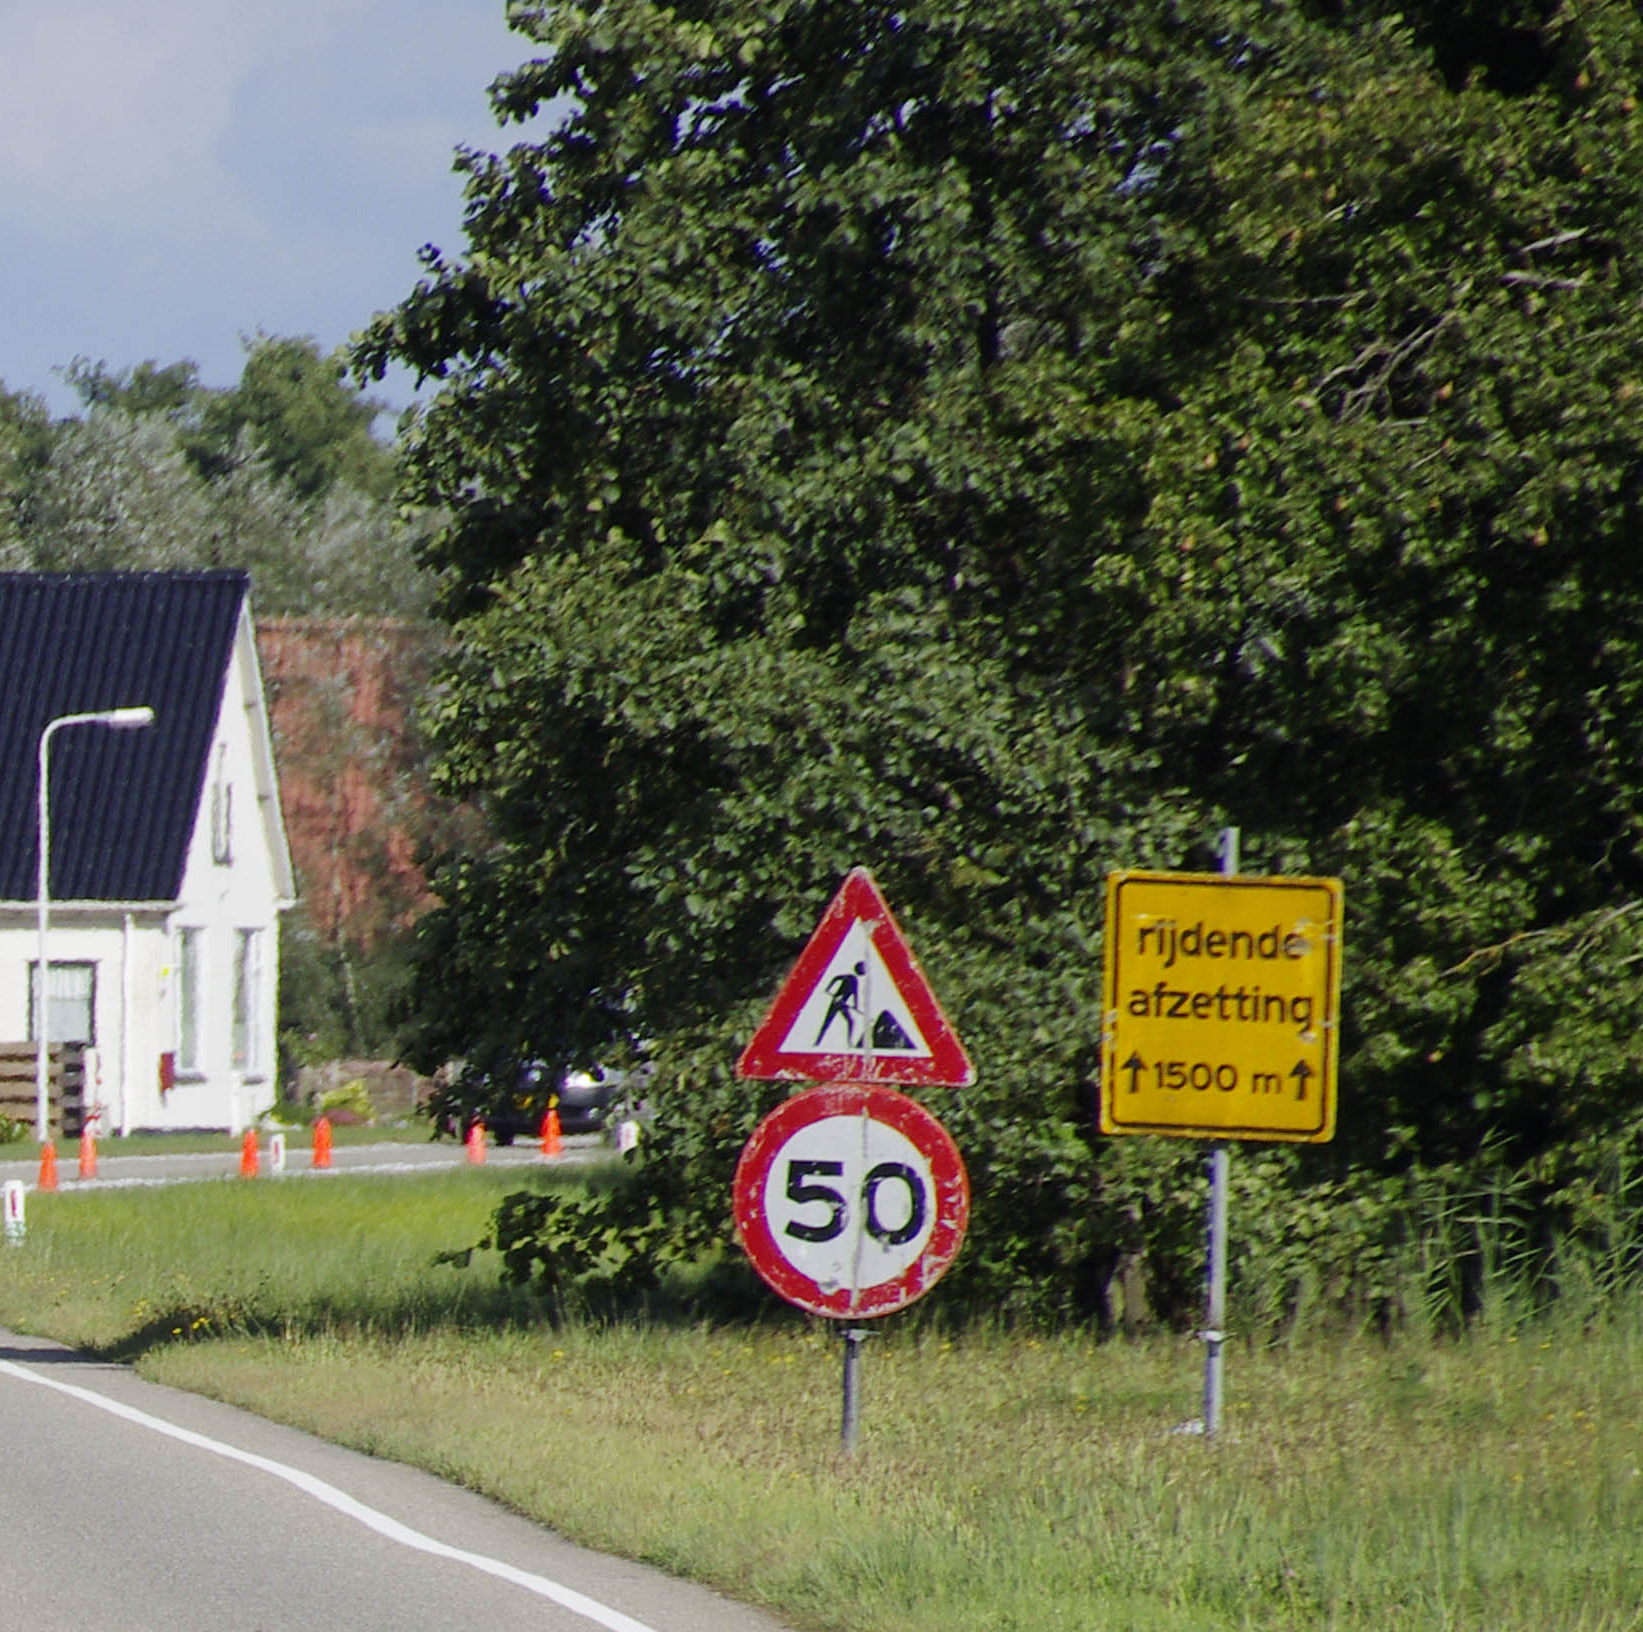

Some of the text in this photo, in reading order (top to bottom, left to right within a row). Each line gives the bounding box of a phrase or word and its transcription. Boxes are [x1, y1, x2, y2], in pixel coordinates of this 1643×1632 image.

[1139, 920, 1306, 968] rijdende
[1129, 982, 1313, 1035] afzetting
[1154, 1061, 1282, 1094] 1500 m
[784, 1160, 926, 1246] 50
